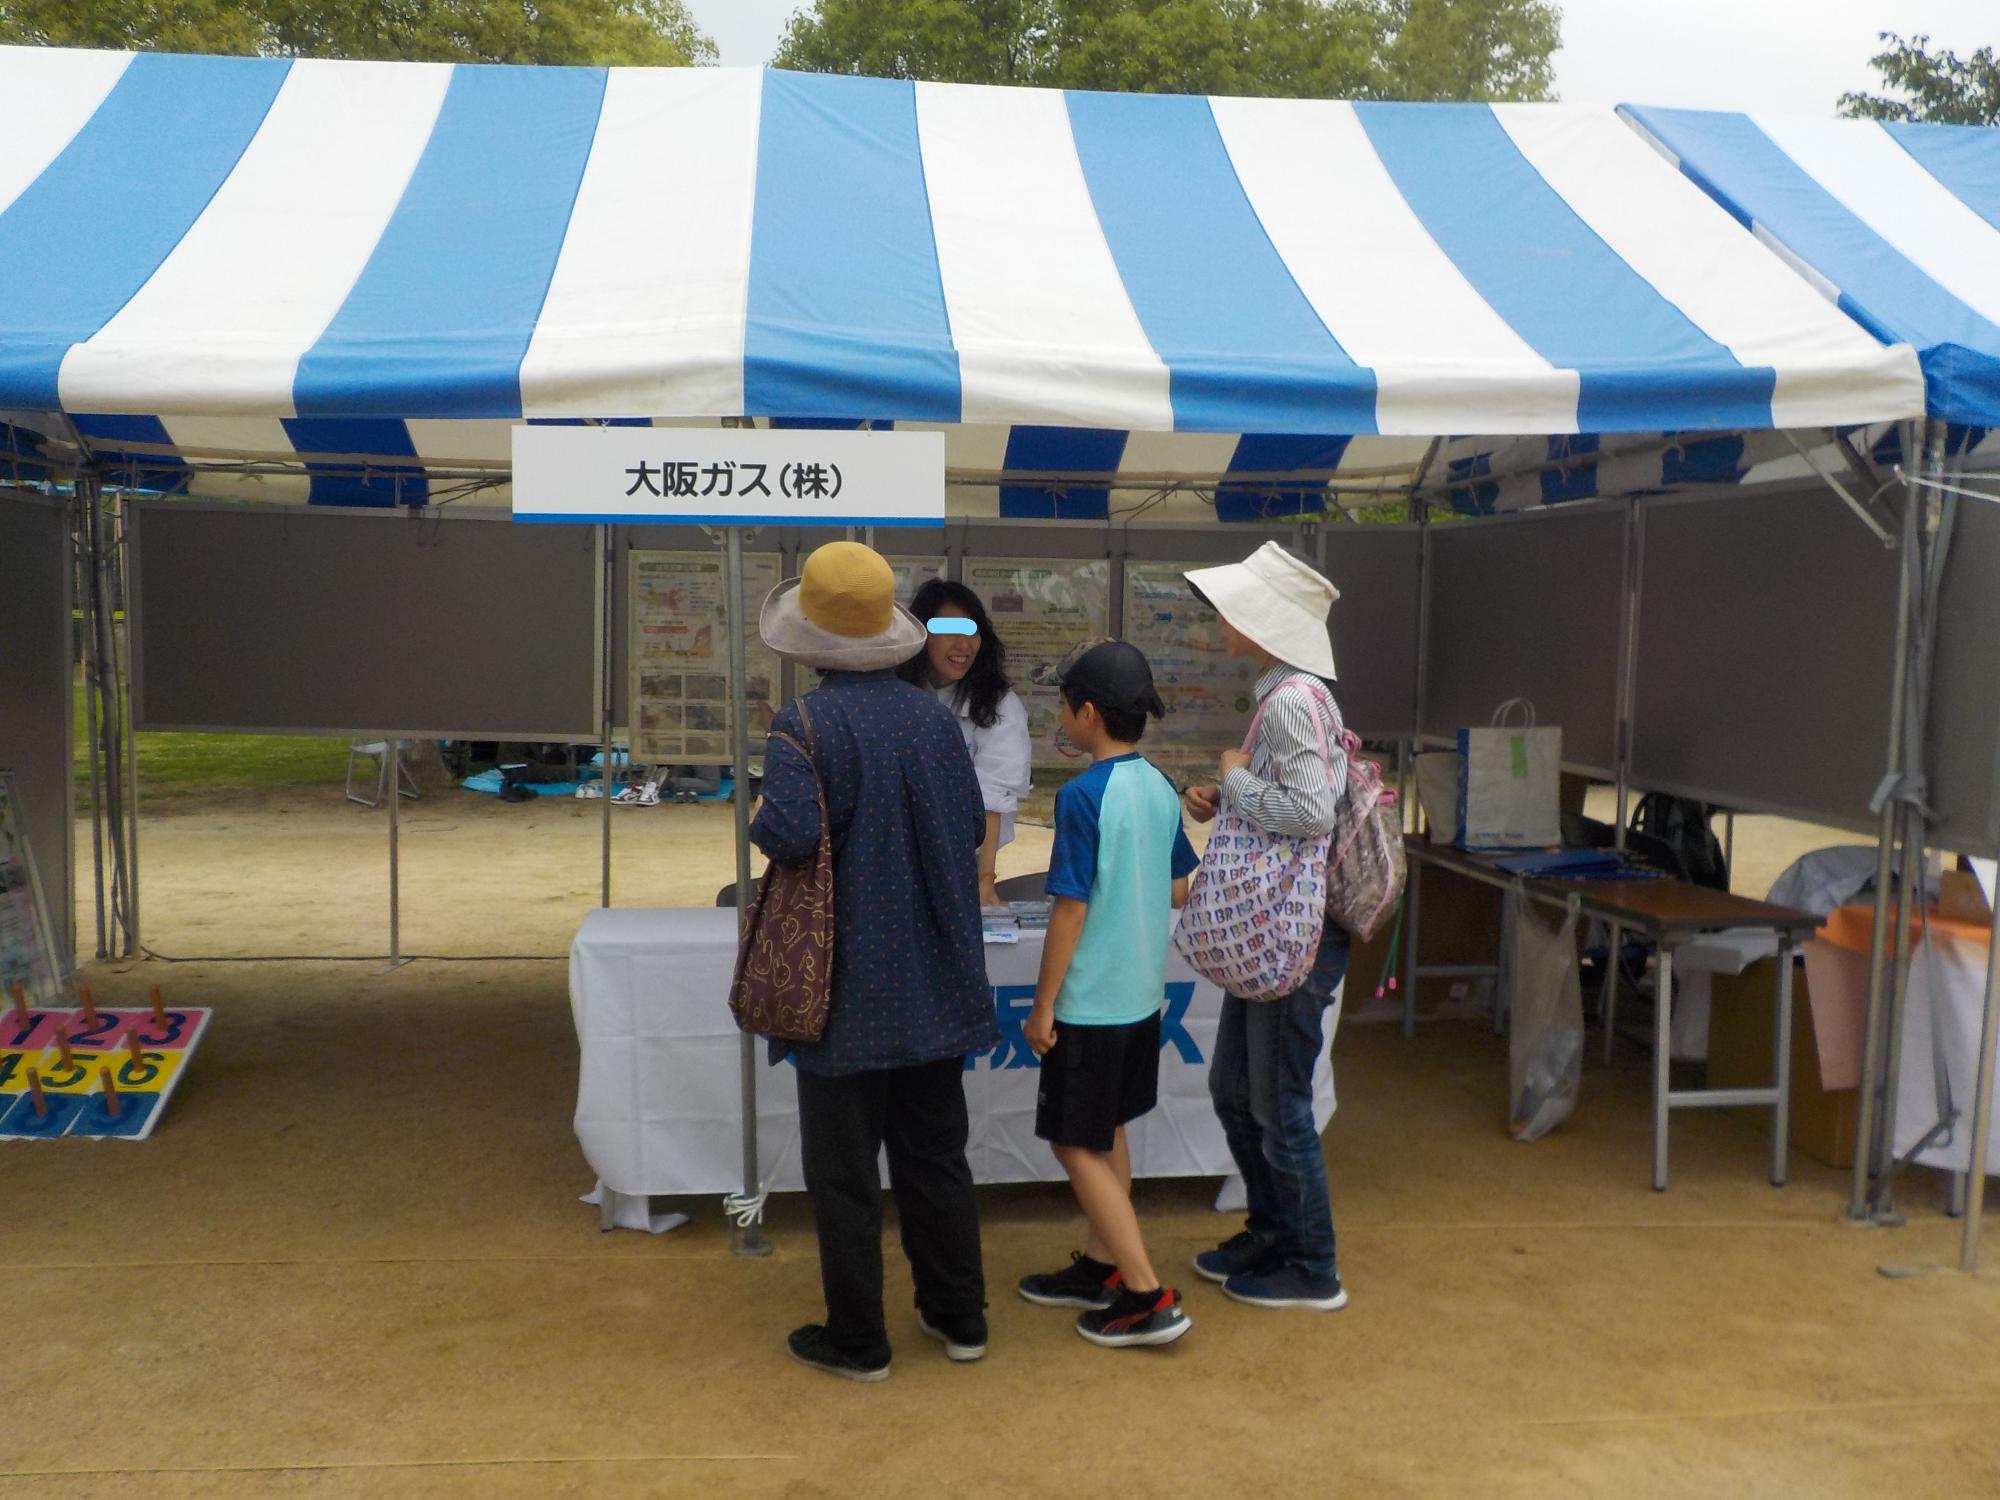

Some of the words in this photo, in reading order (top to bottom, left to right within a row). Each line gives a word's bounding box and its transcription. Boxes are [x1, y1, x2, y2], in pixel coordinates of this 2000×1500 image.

[625, 460, 842, 499] 大阪ガス(株)
[10, 1014, 46, 1045] 1
[68, 1013, 119, 1046] 2
[138, 1012, 187, 1046] 3
[41, 1053, 99, 1088] 5
[117, 1053, 165, 1086] 6
